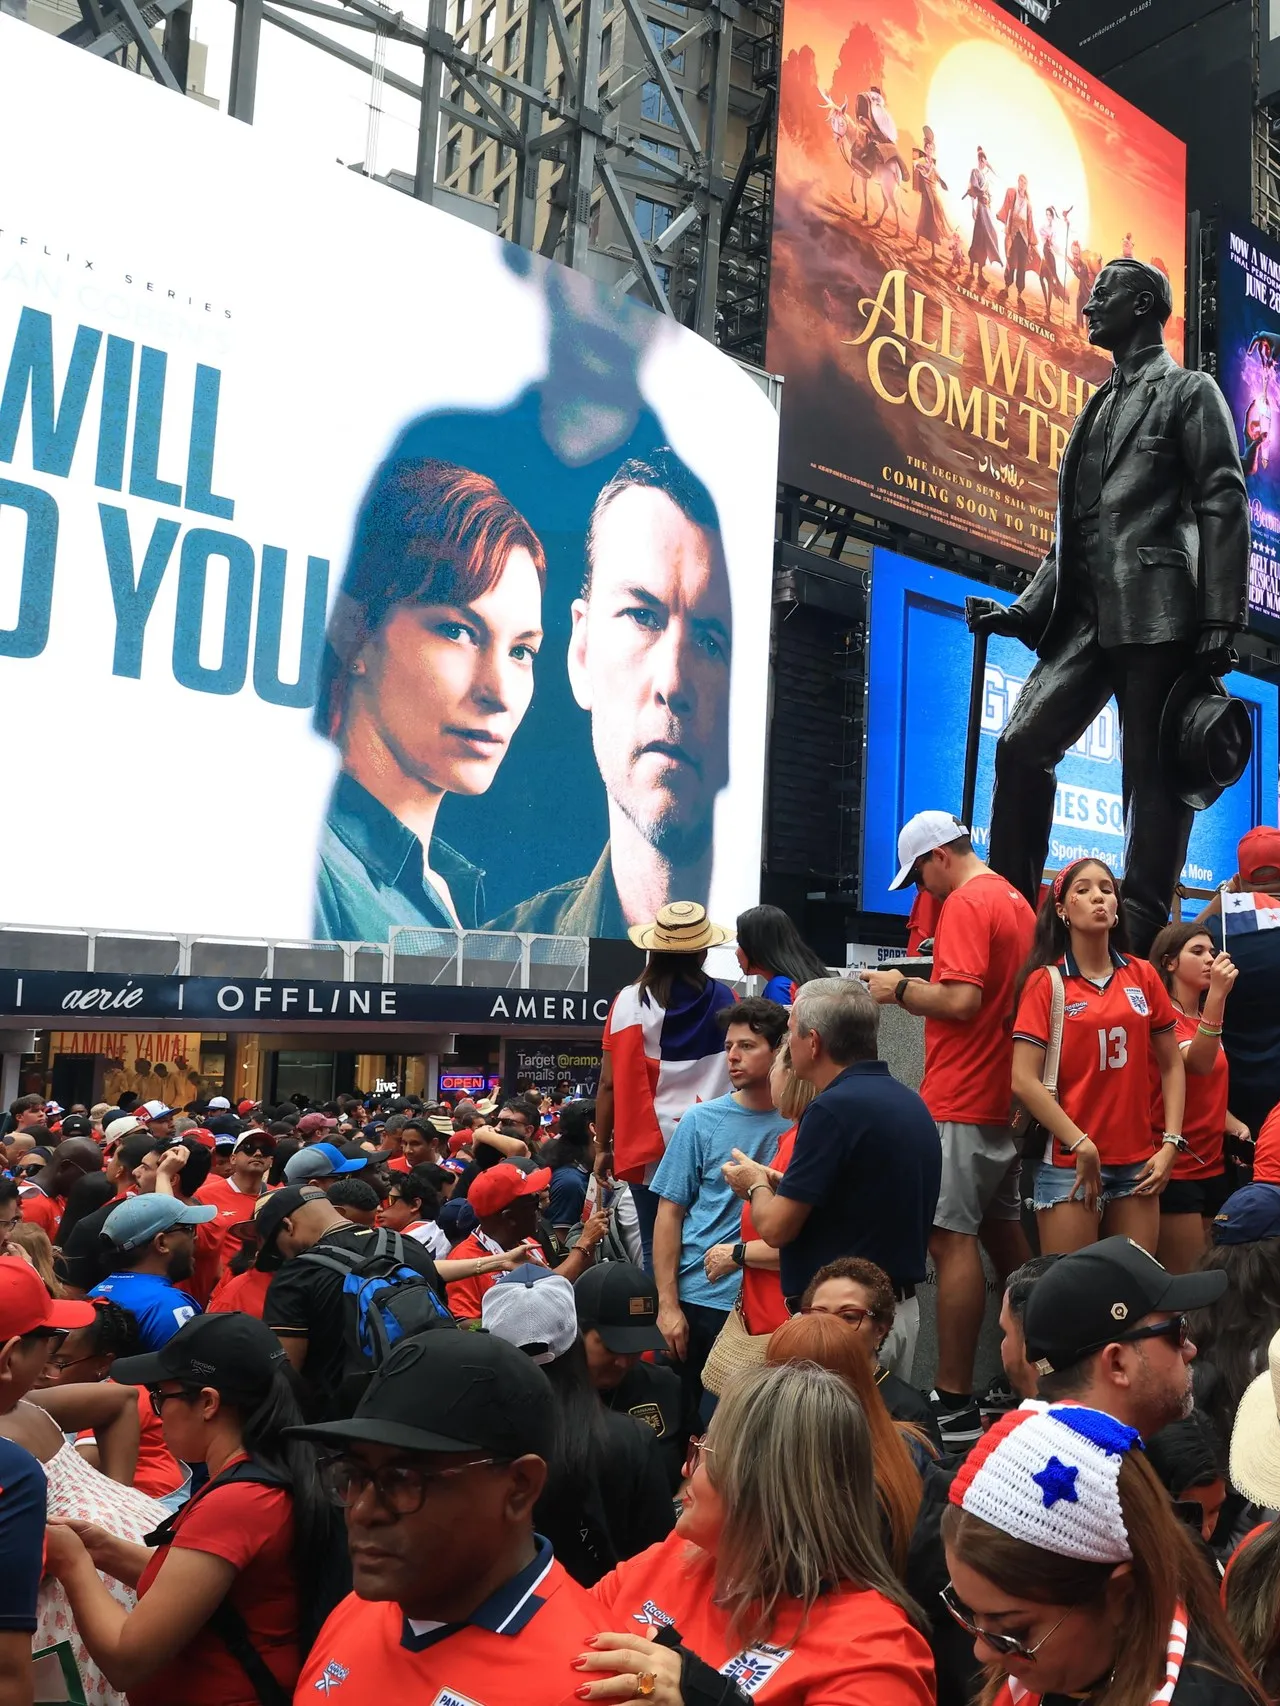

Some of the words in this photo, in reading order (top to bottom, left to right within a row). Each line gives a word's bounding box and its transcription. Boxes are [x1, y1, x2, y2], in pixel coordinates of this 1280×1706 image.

[1229, 232, 1249, 261] NOW
[1230, 252, 1250, 272] FINAL
[124, 272, 232, 320] SERIES
[1245, 273, 1267, 306] JUNE
[840, 268, 965, 365] ALL
[991, 302, 1006, 316] MU
[1006, 308, 1056, 343] ZHENGYANG
[866, 335, 1010, 451] COME
[881, 464, 949, 506] COMING
[955, 493, 999, 524] SOON
[1004, 511, 1025, 533] TO
[906, 455, 928, 473] THE
[932, 465, 973, 490] LEGEND
[975, 484, 1001, 502] SETS
[1004, 493, 1026, 511] SAIL
[97, 501, 331, 711] YOU
[1051, 840, 1090, 863] Sports
[1188, 863, 1213, 882] More
[62, 981, 144, 1010] aerie
[217, 985, 397, 1015] OFFLINE
[59, 1032, 128, 1061] LAMINE
[135, 1033, 189, 1065] YAMAL
[518, 1053, 555, 1068] Target
[1098, 1026, 1128, 1071] 13
[375, 1078, 397, 1093] live
[442, 1077, 483, 1088] OPEN
[556, 1070, 571, 1080] on
